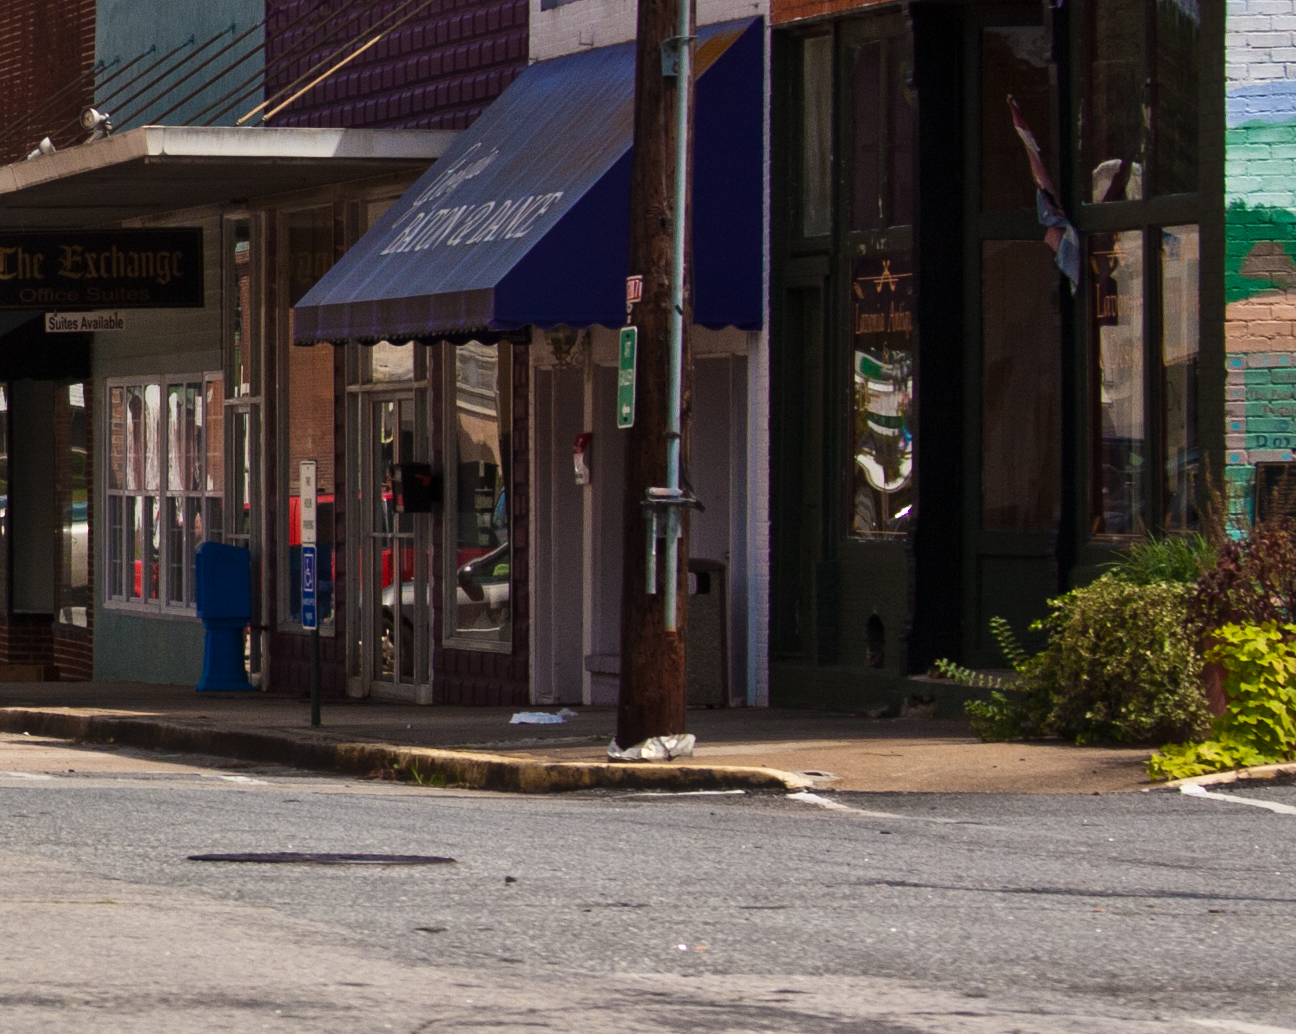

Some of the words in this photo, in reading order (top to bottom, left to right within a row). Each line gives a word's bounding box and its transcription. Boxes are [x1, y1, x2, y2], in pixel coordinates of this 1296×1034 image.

[380, 204, 476, 255] BATON
[446, 200, 496, 246] &
[465, 191, 565, 245] DANCE
[57, 243, 184, 285] Exchange
[19, 287, 79, 303] Office
[86, 286, 150, 302] Suites
[48, 316, 78, 331] Suites
[80, 315, 124, 331] Available
